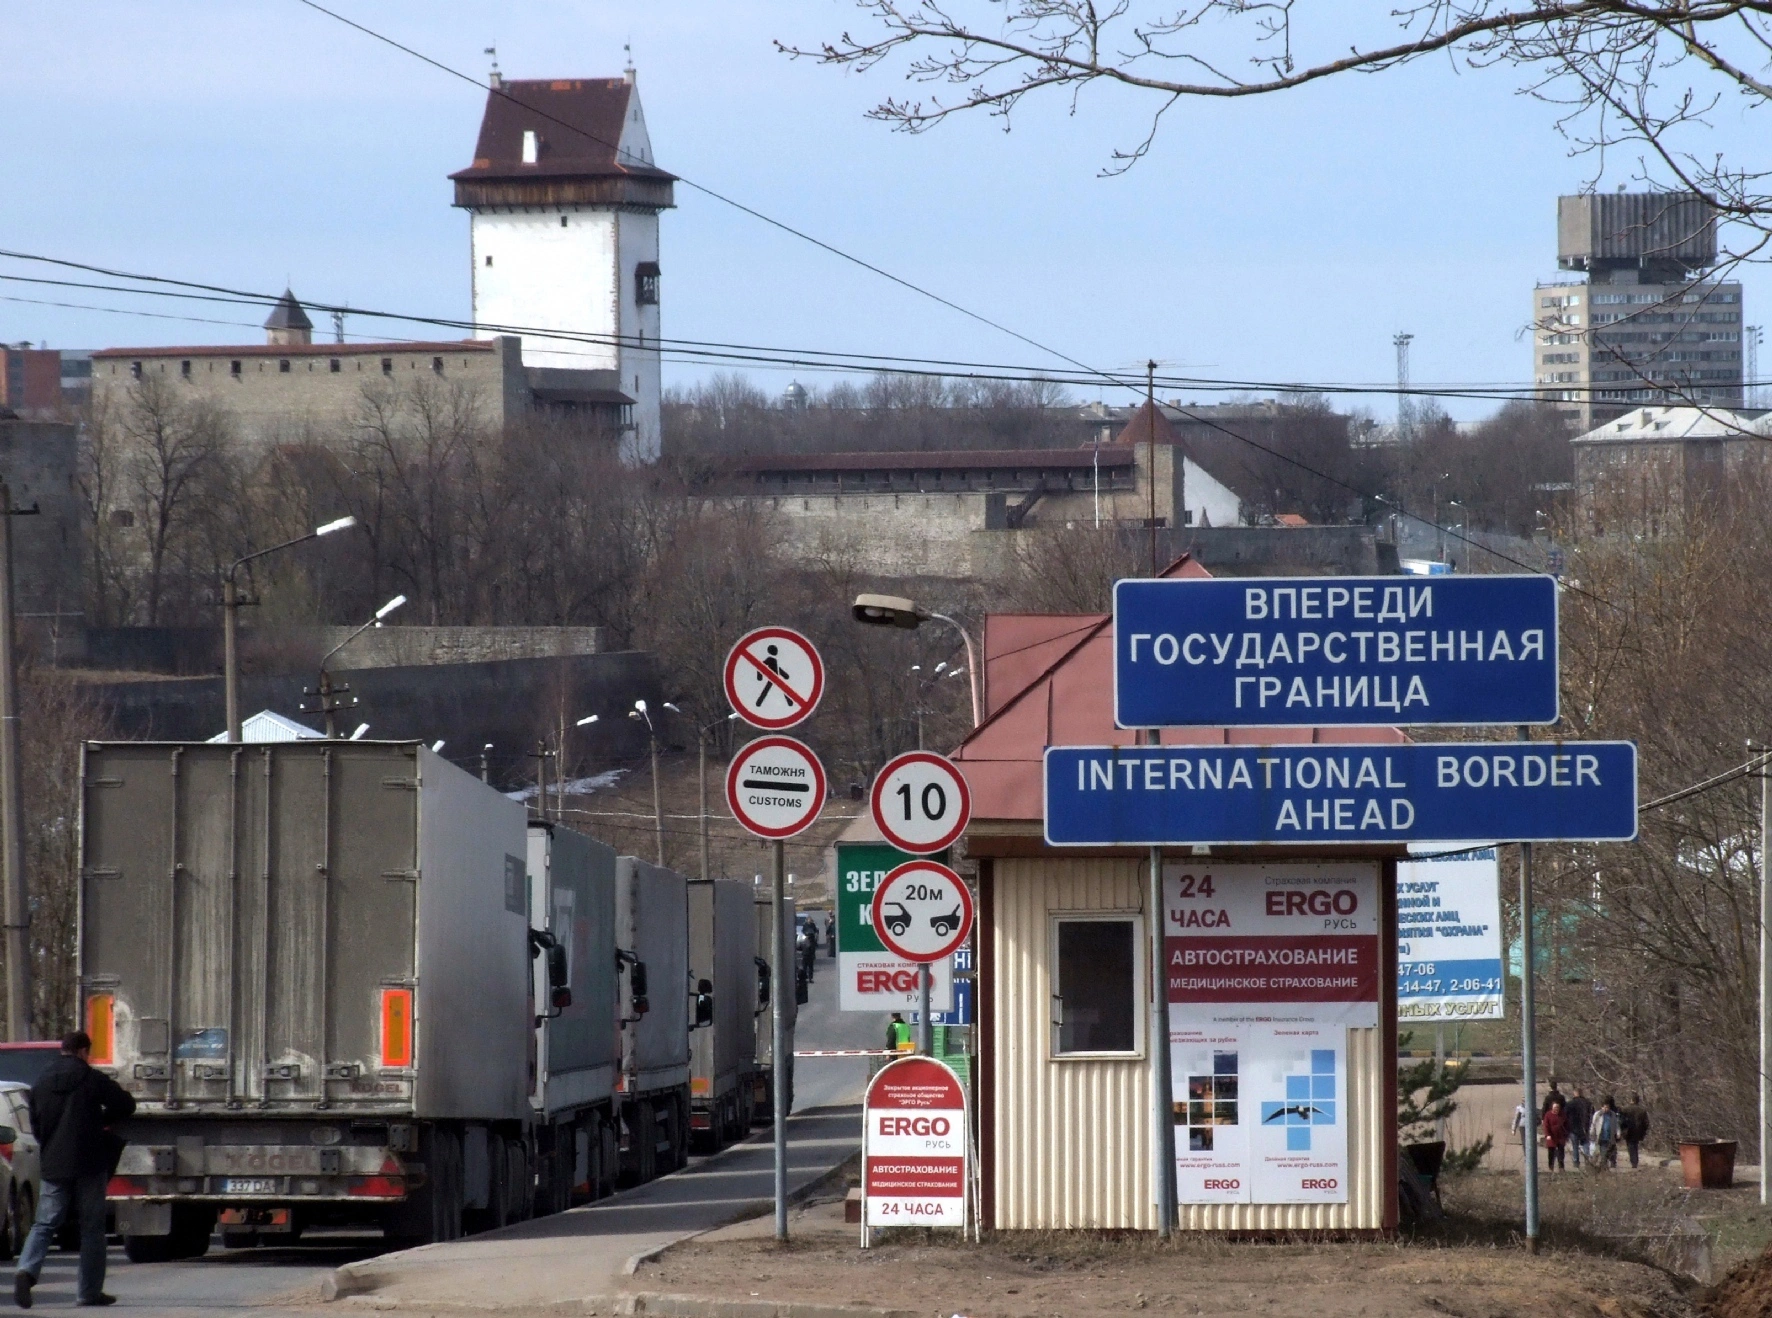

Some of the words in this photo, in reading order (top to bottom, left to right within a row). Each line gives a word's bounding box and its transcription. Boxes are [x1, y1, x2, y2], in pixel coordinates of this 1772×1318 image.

[1245, 586, 1434, 623] ВПЕРЕДИ
[1129, 629, 1545, 670] ГОСУДАРСТВЕННАЯ
[1234, 675, 1430, 714] ГРАНИЦА
[749, 764, 806, 778] ТАМОЖНЯ
[1077, 757, 1407, 791] INTERNATIONAL
[1437, 754, 1602, 788] BORDER
[748, 795, 802, 809] CUSTOMS
[896, 782, 947, 821] 10
[1274, 798, 1416, 832] AHEAD
[1179, 874, 1216, 899] 24
[1264, 876, 1311, 887] Страховая
[1313, 876, 1357, 885] компания
[1406, 882, 1439, 893] УСЛУГ
[1265, 889, 1358, 916] ERGO
[1170, 909, 1231, 928] ЧАСА
[1324, 918, 1357, 929] РУСЬ
[1171, 948, 1358, 966] АВТОСТРАХОВАНИЕ
[1170, 977, 1267, 990] МЕДИЦИНСКОЕ
[1270, 977, 1358, 988] СТРАХОВАНИЕ
[1450, 978, 1501, 992] 2-06-41
[1445, 1001, 1498, 1016] УСЛУГ
[879, 1116, 950, 1137] ERGO
[925, 1140, 952, 1149] РУСЬ
[872, 1165, 958, 1174] АВТОСТРАХОВАНИЕ
[1204, 1179, 1240, 1189] ERGO
[1302, 1178, 1338, 1189] ERGO
[882, 1203, 900, 1215] 24
[904, 1203, 944, 1216] ЧАСА
